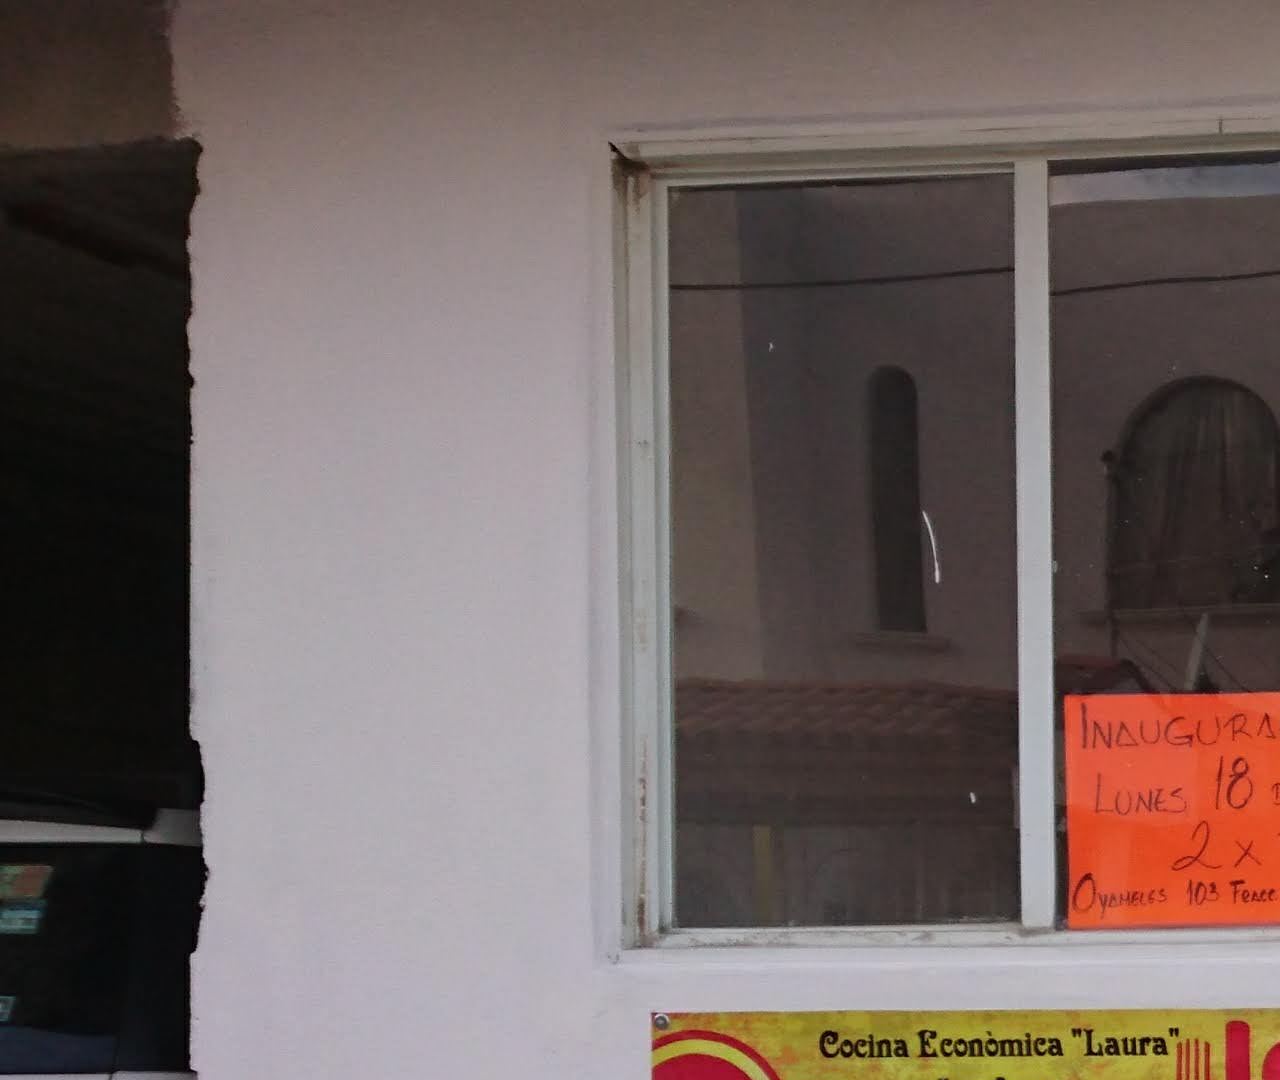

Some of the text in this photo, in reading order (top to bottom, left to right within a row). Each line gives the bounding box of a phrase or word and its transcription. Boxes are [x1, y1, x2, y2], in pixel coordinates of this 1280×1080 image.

[1094, 772, 1188, 816] LUNES
[1215, 755, 1254, 810] 18
[1171, 820, 1222, 872] 2
[1071, 872, 1168, 915] OYAMELES
[1186, 879, 1220, 906] 103
[818, 1029, 910, 1059] Cocina
[1071, 1027, 1180, 1057] "Laura"
